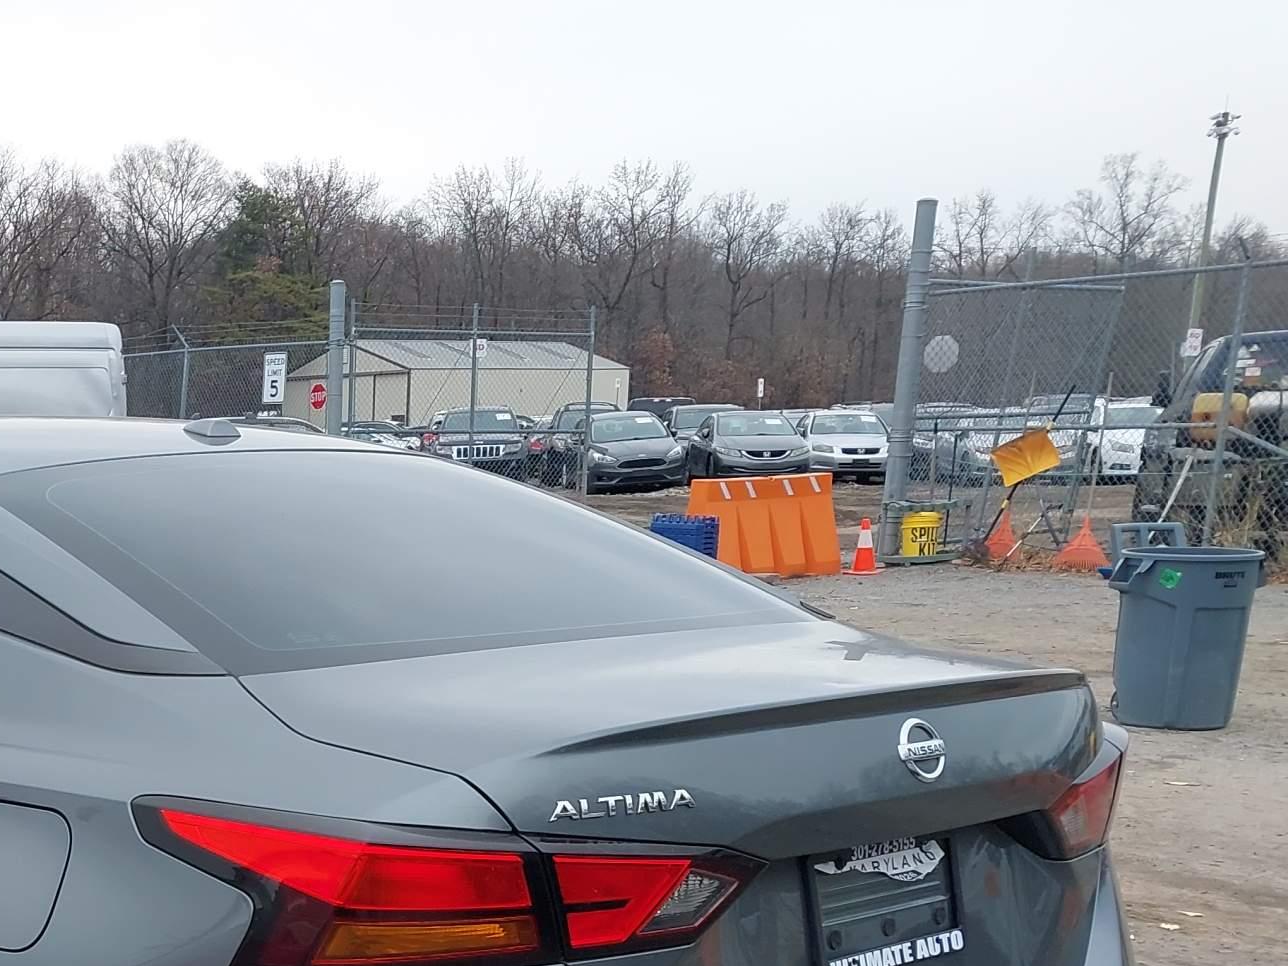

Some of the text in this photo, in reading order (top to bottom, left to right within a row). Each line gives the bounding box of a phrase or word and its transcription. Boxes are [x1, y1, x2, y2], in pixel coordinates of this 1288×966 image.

[266, 357, 285, 366] SPEED
[267, 368, 283, 377] LIMIT
[269, 379, 279, 398] 5
[311, 391, 327, 402] STOP
[918, 542, 936, 556] KIT
[906, 742, 945, 758] NISSAN
[548, 788, 696, 823] ALTIMA
[916, 930, 964, 960] AUTO
